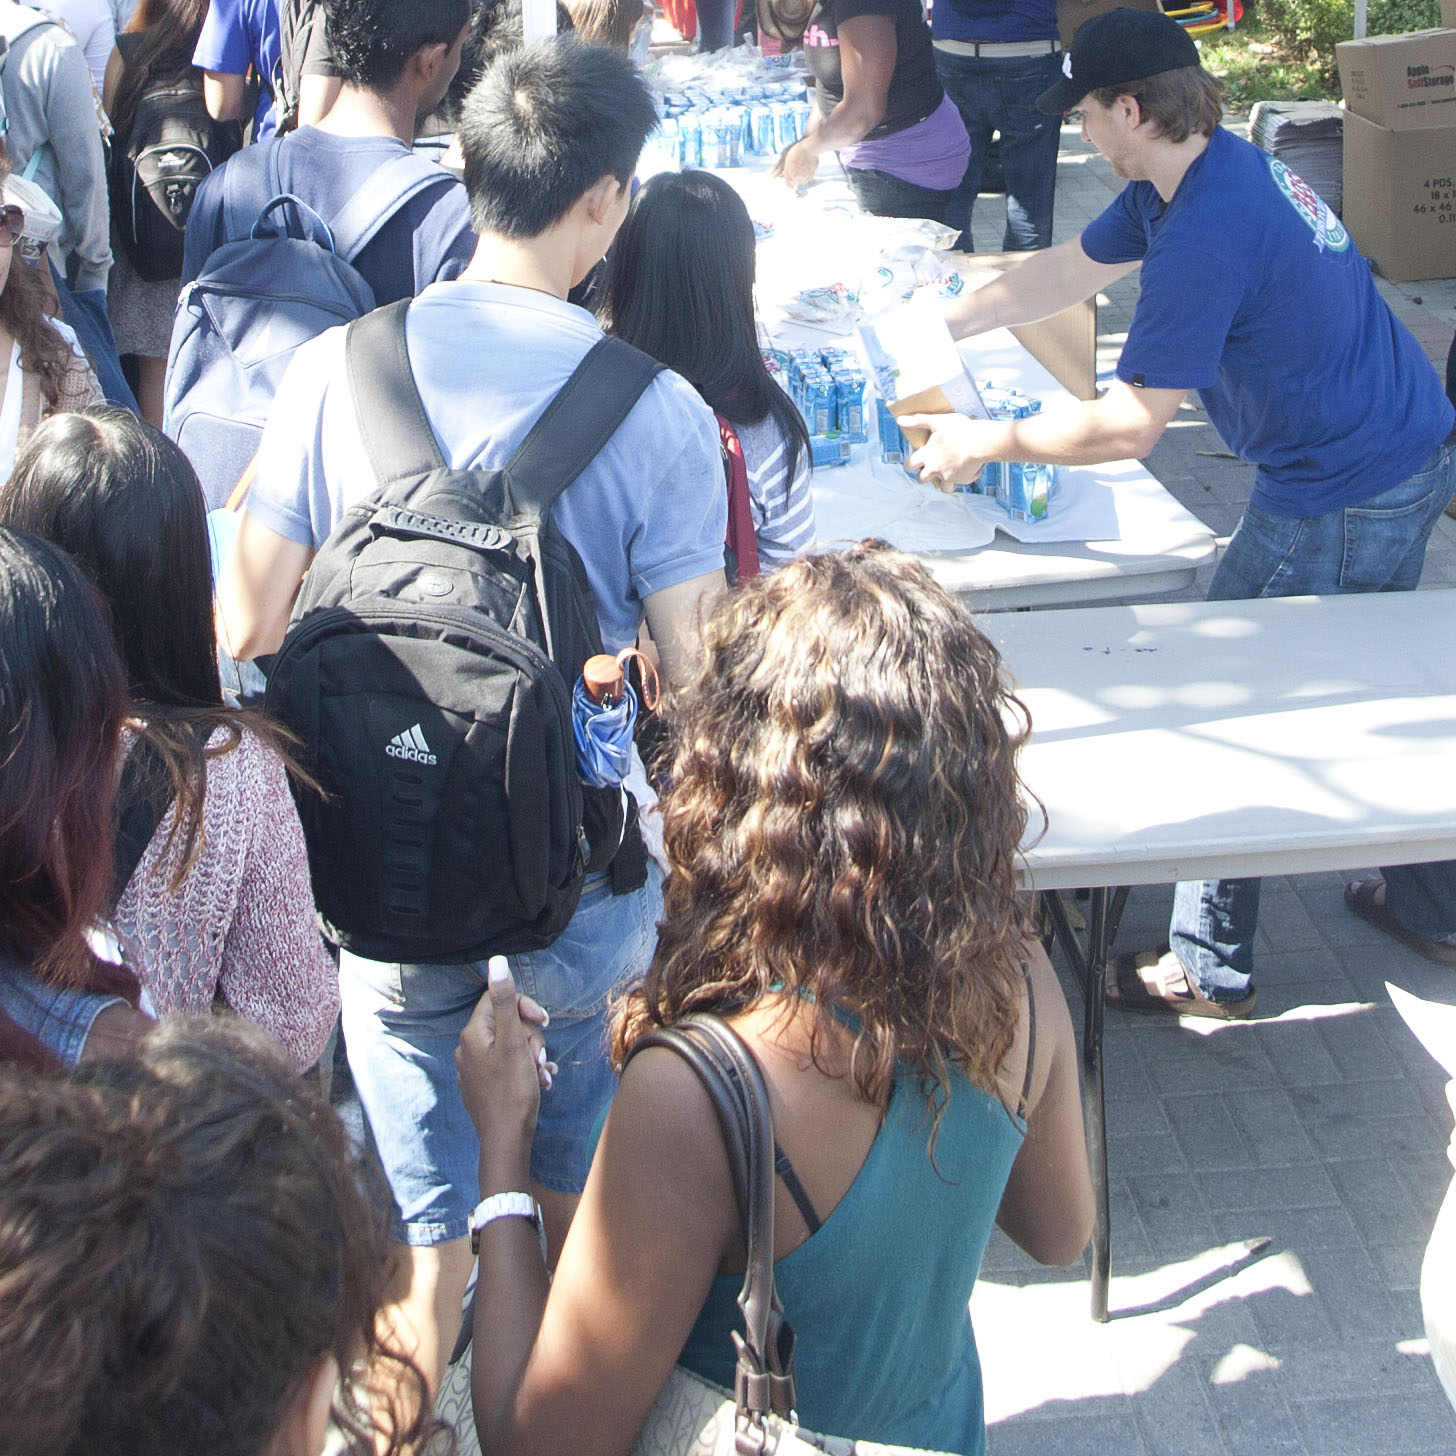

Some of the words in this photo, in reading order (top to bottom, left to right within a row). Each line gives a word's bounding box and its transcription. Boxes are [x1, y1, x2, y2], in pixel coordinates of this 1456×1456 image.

[1407, 64, 1429, 77] Apple
[1408, 74, 1455, 89] SelfStorage
[1424, 180, 1430, 188] 4
[1433, 177, 1456, 188] PDS.
[1413, 204, 1427, 213] 46
[1439, 202, 1452, 211] 46
[385, 745, 437, 765] adidas
